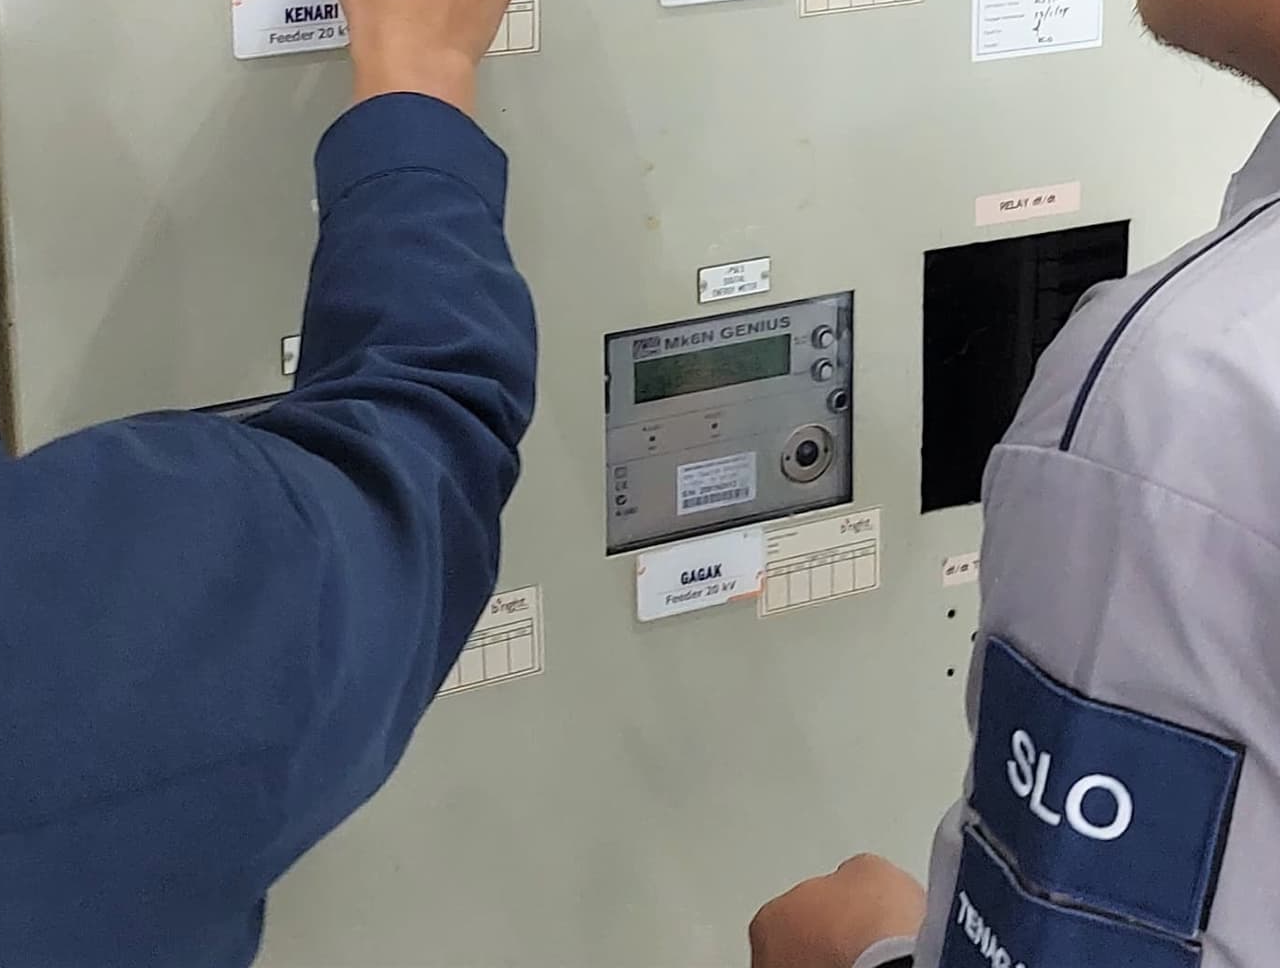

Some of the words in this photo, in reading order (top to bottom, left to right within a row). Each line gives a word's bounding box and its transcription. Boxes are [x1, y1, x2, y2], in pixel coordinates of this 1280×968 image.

[285, 3, 339, 24] KENARI
[270, 31, 313, 44] Feeder
[317, 28, 334, 40] 20
[664, 331, 714, 350] Mk6N
[720, 315, 791, 340] GENIUS
[680, 563, 723, 586] GAGAK
[665, 589, 703, 606] Feeder
[706, 585, 720, 596] 20
[722, 580, 737, 593] kV
[1006, 729, 1134, 841] SLO
